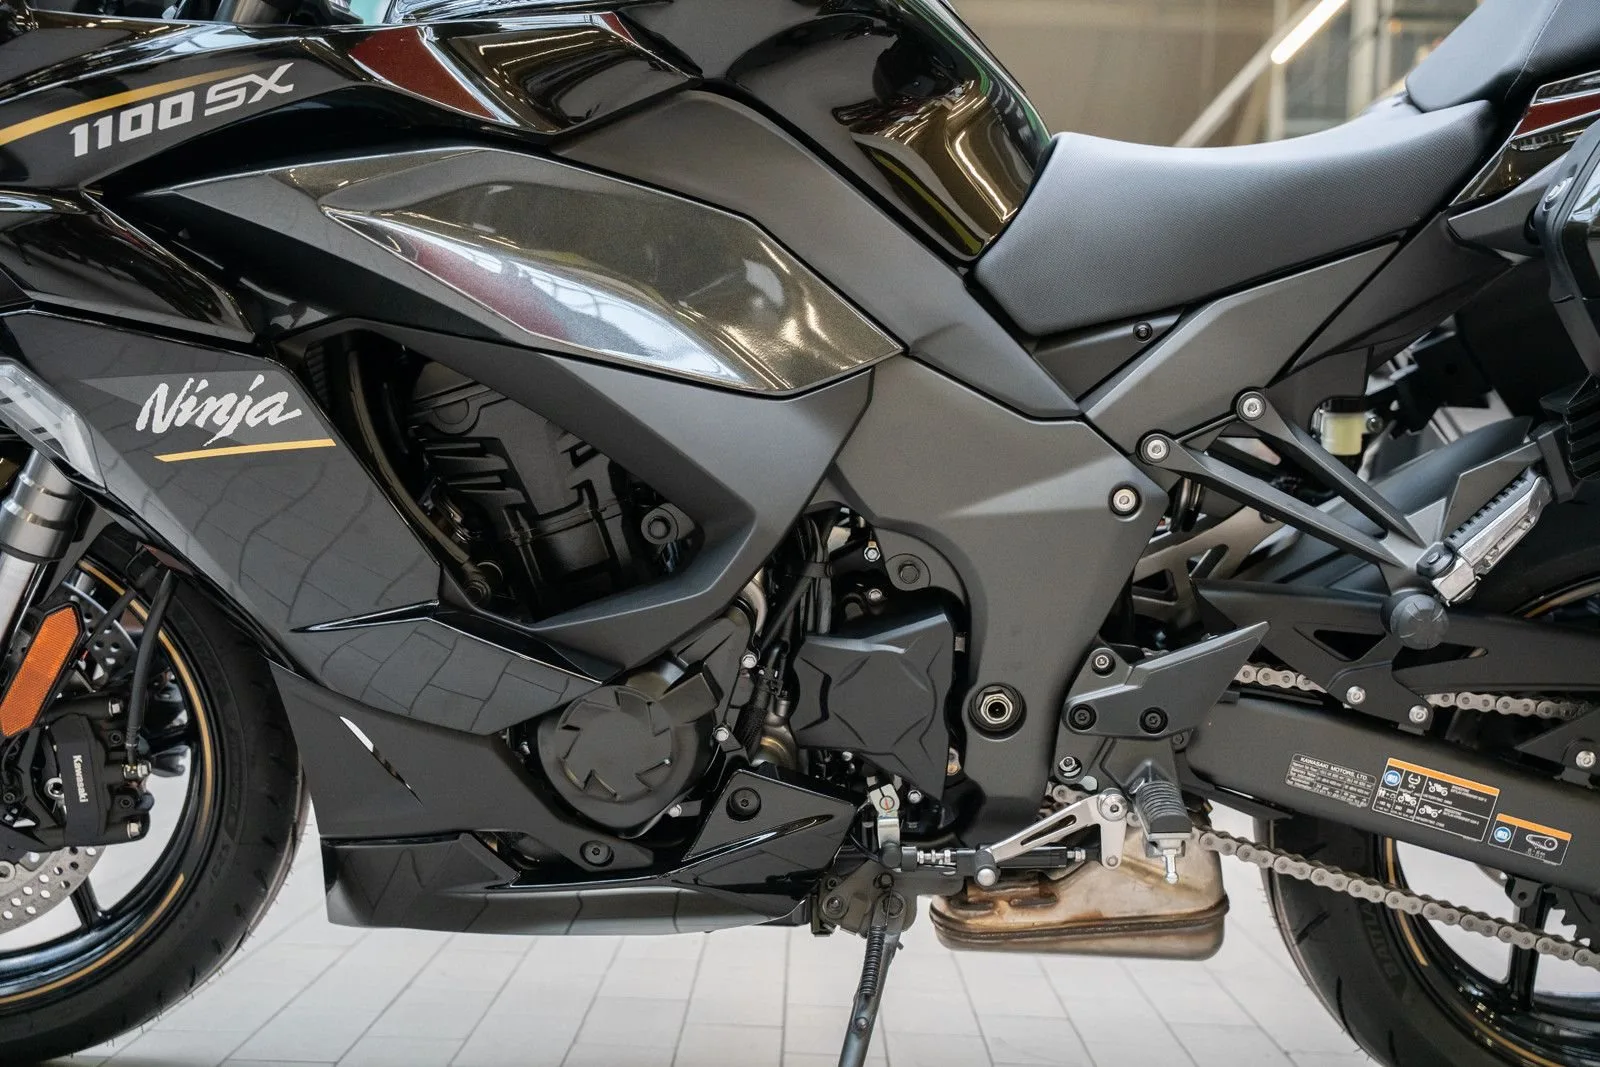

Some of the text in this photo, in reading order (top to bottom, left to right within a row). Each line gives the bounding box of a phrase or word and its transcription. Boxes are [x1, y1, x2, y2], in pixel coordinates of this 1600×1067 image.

[69, 62, 294, 157] 1100 SX
[135, 374, 302, 447] Ninja
[72, 754, 89, 803] Kawasaki
[1300, 757, 1329, 769] KAWASAKI
